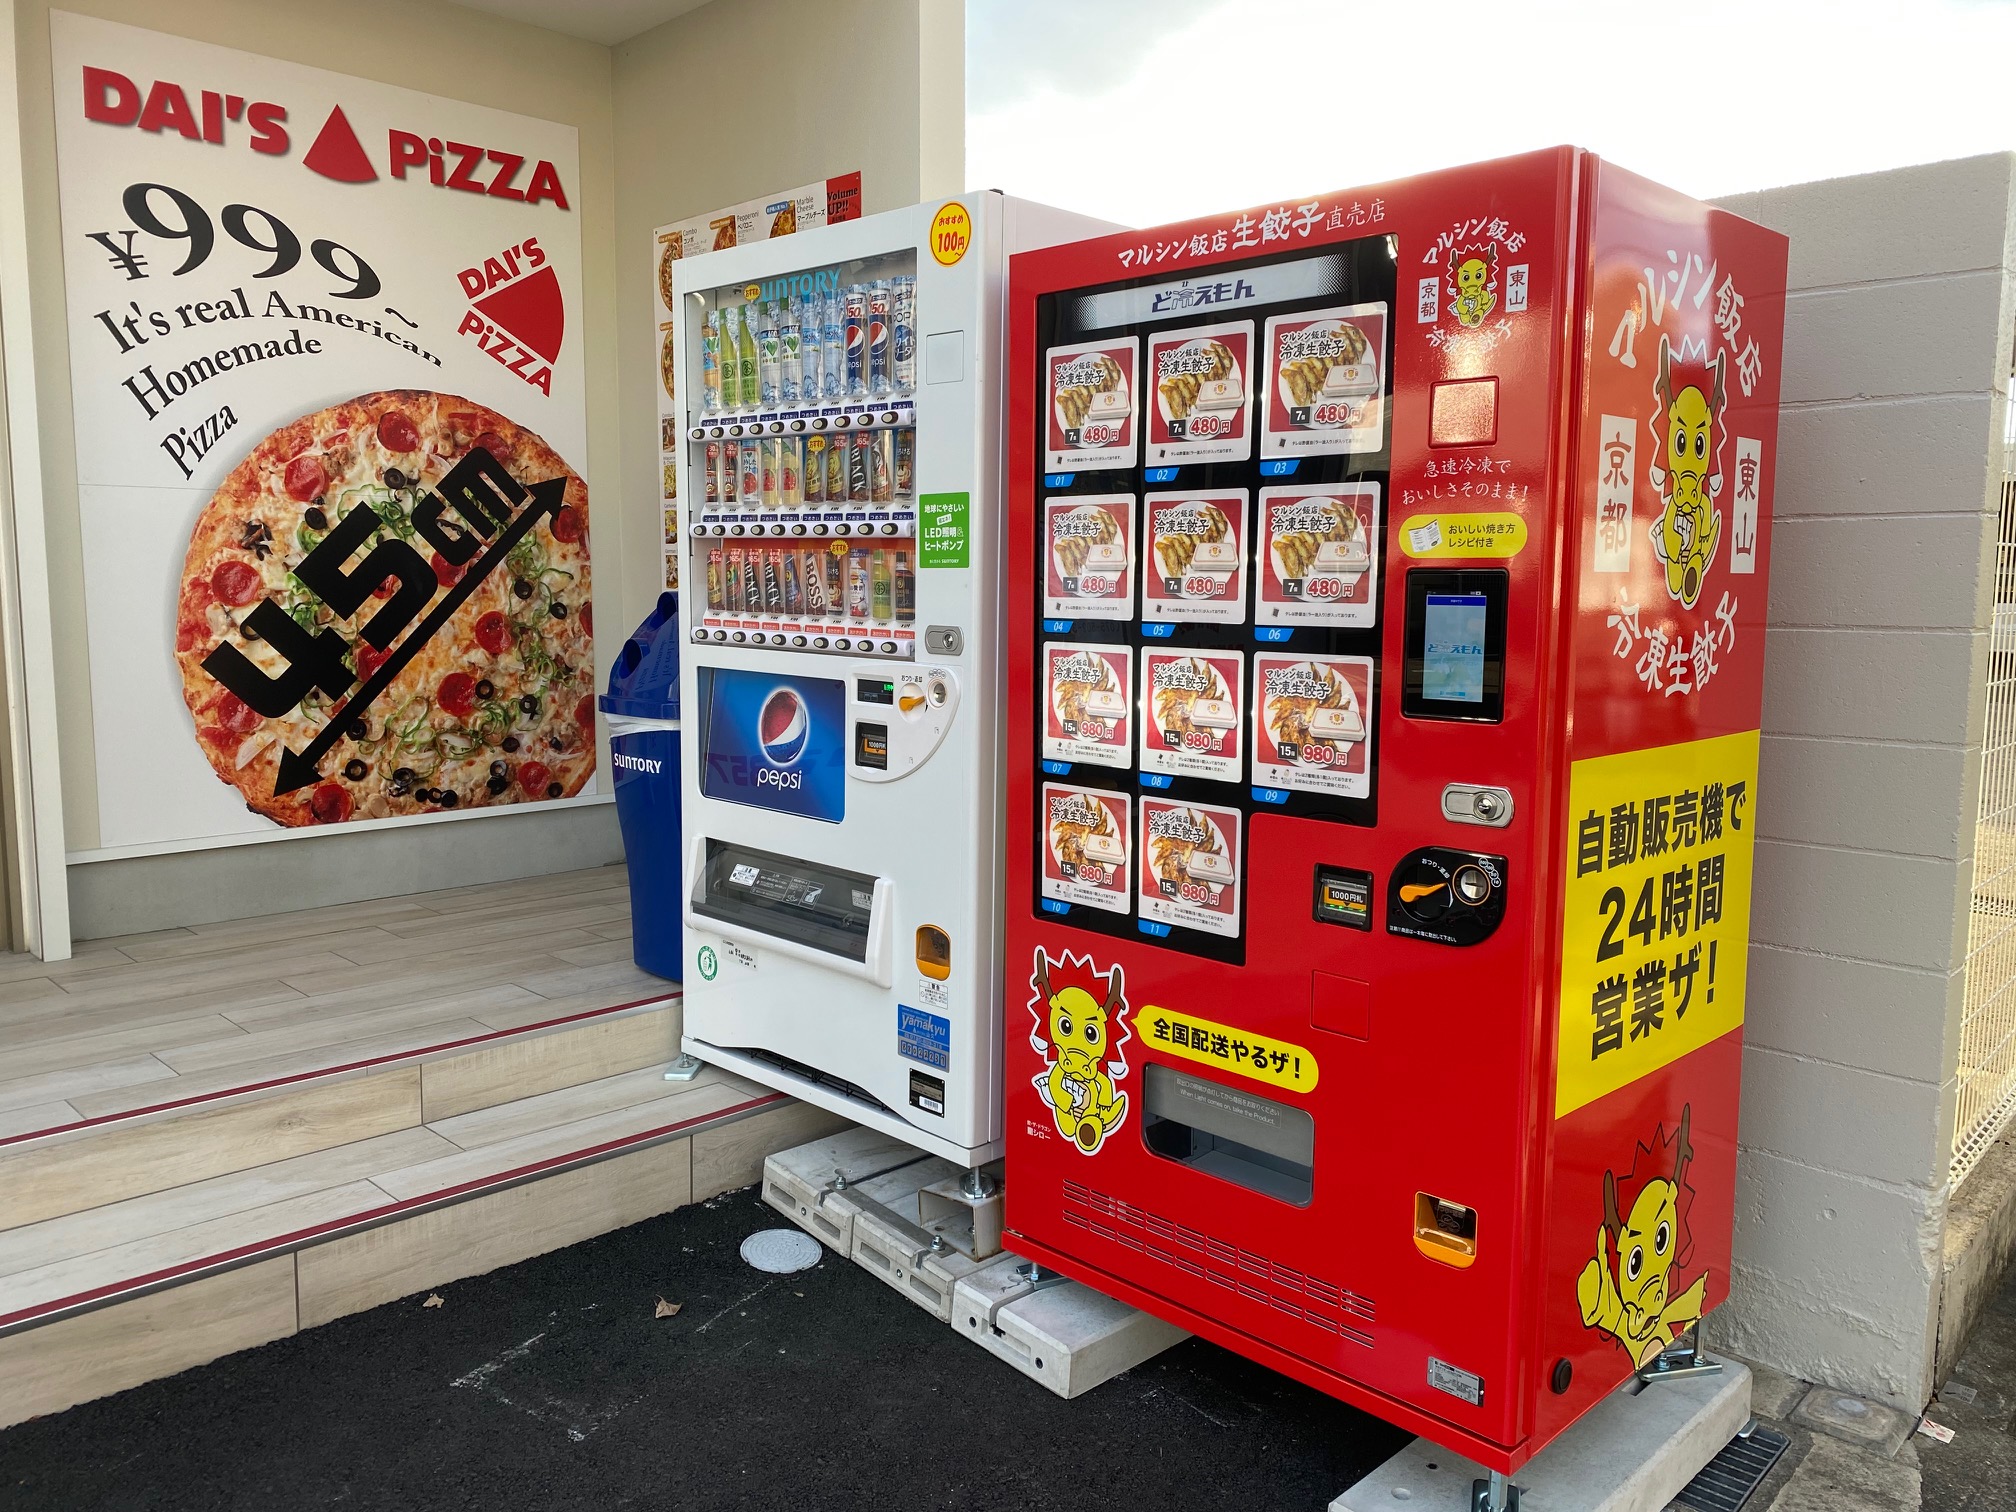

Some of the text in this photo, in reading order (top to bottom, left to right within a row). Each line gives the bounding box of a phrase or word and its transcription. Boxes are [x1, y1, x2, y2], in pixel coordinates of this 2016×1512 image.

[82, 65, 289, 155] DAI'S
[827, 187, 858, 202] Volume
[737, 211, 759, 221] Pepperoni
[797, 204, 815, 214] Cheese
[827, 200, 848, 216] UP!!
[938, 214, 964, 226] おすすめ
[683, 228, 697, 237] Combo
[1422, 216, 1527, 265] マルシン飯店
[456, 237, 546, 300] DAI'S
[757, 268, 842, 303] UNTORY
[1509, 270, 1526, 306] 東山
[1421, 282, 1438, 317] 京都
[93, 287, 442, 369] It's real American
[1608, 250, 1763, 398] マルシン飯店
[1279, 329, 1327, 342] マルシン飯店
[1157, 347, 1200, 361] マルシン飯店
[1279, 339, 1345, 359] 冷凍生餃子
[121, 328, 322, 421] Homemade
[1054, 360, 1091, 373] マルシン飯店
[1157, 357, 1215, 378] 冷凍生餃子
[1054, 370, 1104, 388] 冷凍生餃子
[1083, 427, 1120, 442] 480円
[1189, 417, 1231, 436] 480円
[158, 401, 239, 482] Pizza
[1157, 470, 1168, 480] 02
[1274, 462, 1286, 473] 03
[1423, 458, 1512, 479] 急速冷凍で
[1055, 476, 1065, 486] 01
[1402, 482, 1528, 504] おいしさそのまま!
[1600, 431, 1632, 555] 京都
[924, 503, 964, 513] 地球にやさしい
[1154, 508, 1195, 519] マルシン飯店
[1272, 505, 1319, 517] マルシン飯店
[1734, 452, 1758, 558] 東山
[1053, 513, 1088, 523] マルシン飯店
[1154, 518, 1210, 534] 冷凍生餃子
[1272, 514, 1336, 532] 冷凍生餃子
[924, 526, 964, 538] LED照明&
[1053, 522, 1103, 537] 冷凍生餃子
[1449, 523, 1516, 535] おいしい焼き方
[924, 540, 964, 551] ヒートポンプ
[1449, 537, 1495, 548] レシピ付き
[806, 561, 823, 608] BOSS
[1081, 576, 1117, 593] 480円
[1185, 577, 1226, 594] 480円
[1306, 578, 1354, 597] 480円
[1053, 622, 1063, 631] 04
[1153, 625, 1164, 635] 05
[1268, 629, 1281, 639] 06
[1607, 586, 1739, 699] 冷凍生餃子
[1053, 656, 1088, 667] マルシン飯店
[1153, 663, 1193, 674] マルシン飯店
[1053, 666, 1101, 684] 冷凍生餃子
[1153, 672, 1208, 690] 冷凍生餃子
[1265, 668, 1313, 681] マルシン飯店
[1265, 678, 1330, 699] 冷凍生餃子
[1081, 721, 1114, 740] 980円
[1185, 732, 1223, 751] 980円
[1302, 743, 1348, 766] 980円
[1052, 763, 1062, 772] 07
[757, 766, 802, 790] pepsi
[1151, 776, 1162, 786] 08
[1265, 790, 1278, 801] 09
[1050, 797, 1087, 812] マルシン飯店
[1050, 807, 1099, 826] 冷凍生餃子
[1148, 811, 1190, 825] マルシン飯店
[1148, 823, 1205, 843] 冷凍生餃子
[1576, 779, 1748, 879] 自動販売機で
[1079, 864, 1113, 885] 980円
[1180, 882, 1220, 906] 980円
[1331, 891, 1364, 903] 1000円札
[1052, 902, 1061, 912] 10
[1596, 853, 1726, 964] 24時間
[1150, 922, 1160, 934] 11
[1590, 940, 1717, 1062] 営業ザ!
[902, 1013, 946, 1037] yamakyu
[1153, 1018, 1301, 1078] 全国配送やるザ!
[1180, 1089, 1194, 1098] When
[1194, 1093, 1207, 1102] Light
[1207, 1098, 1223, 1107] comes
[1232, 1106, 1243, 1114] take
